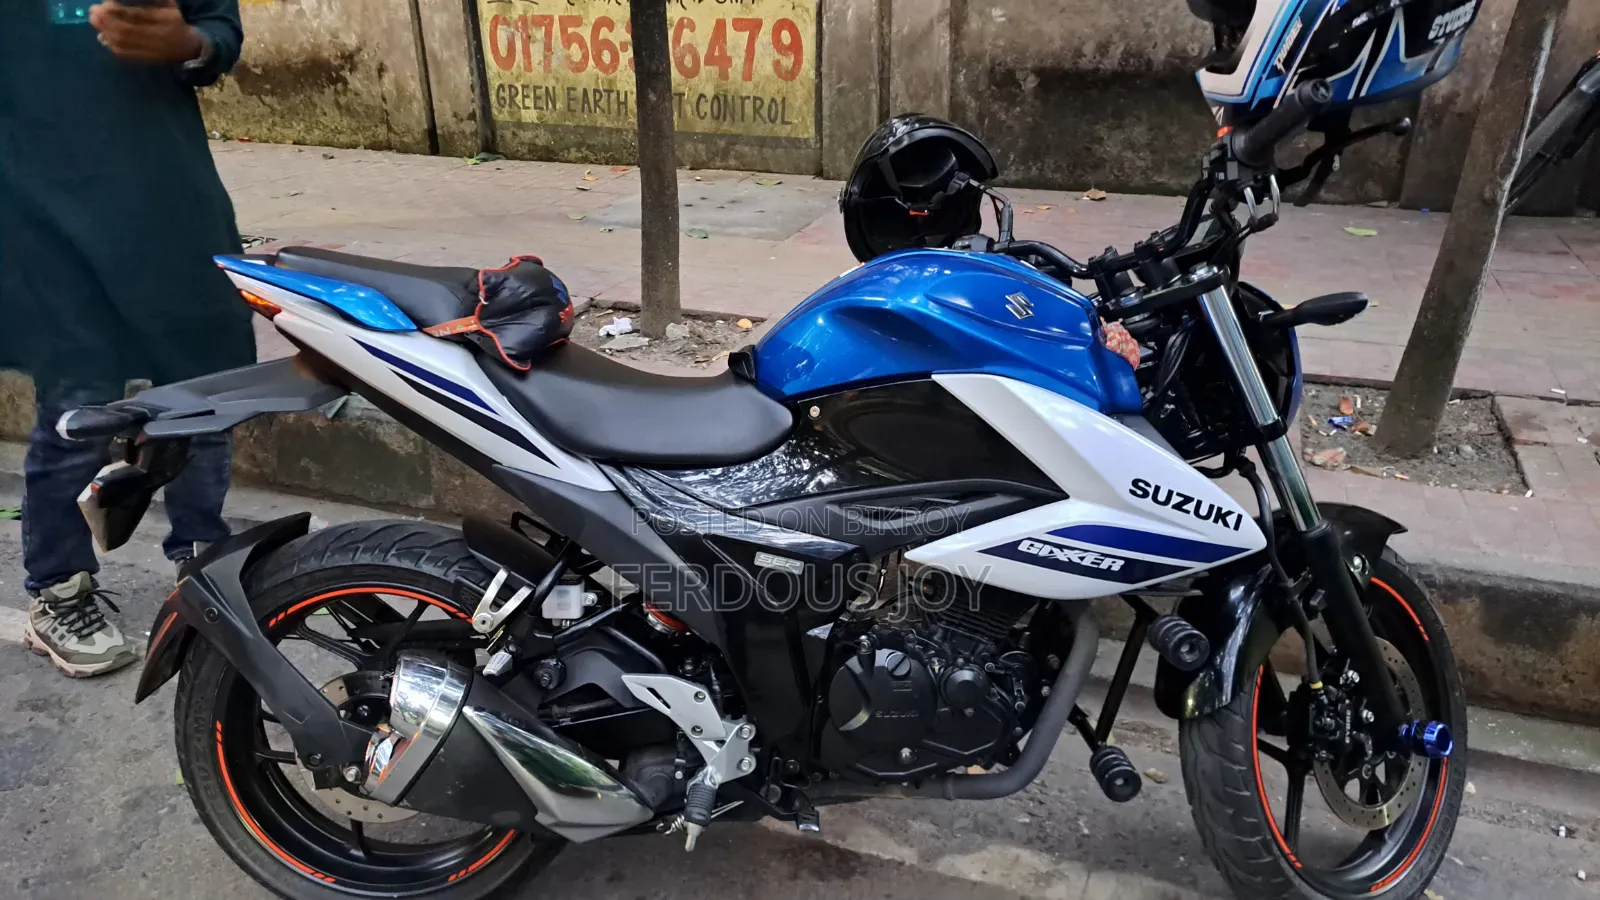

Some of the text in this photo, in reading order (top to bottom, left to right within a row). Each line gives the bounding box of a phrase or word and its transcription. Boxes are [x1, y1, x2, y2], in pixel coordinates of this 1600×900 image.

[496, 83, 557, 112] GREEN
[566, 86, 628, 117] EARTH
[695, 91, 792, 126] CONTROL
[1128, 477, 1244, 532] SUZUKI
[757, 554, 801, 568] SEP
[1017, 539, 1126, 572] GIXXER
